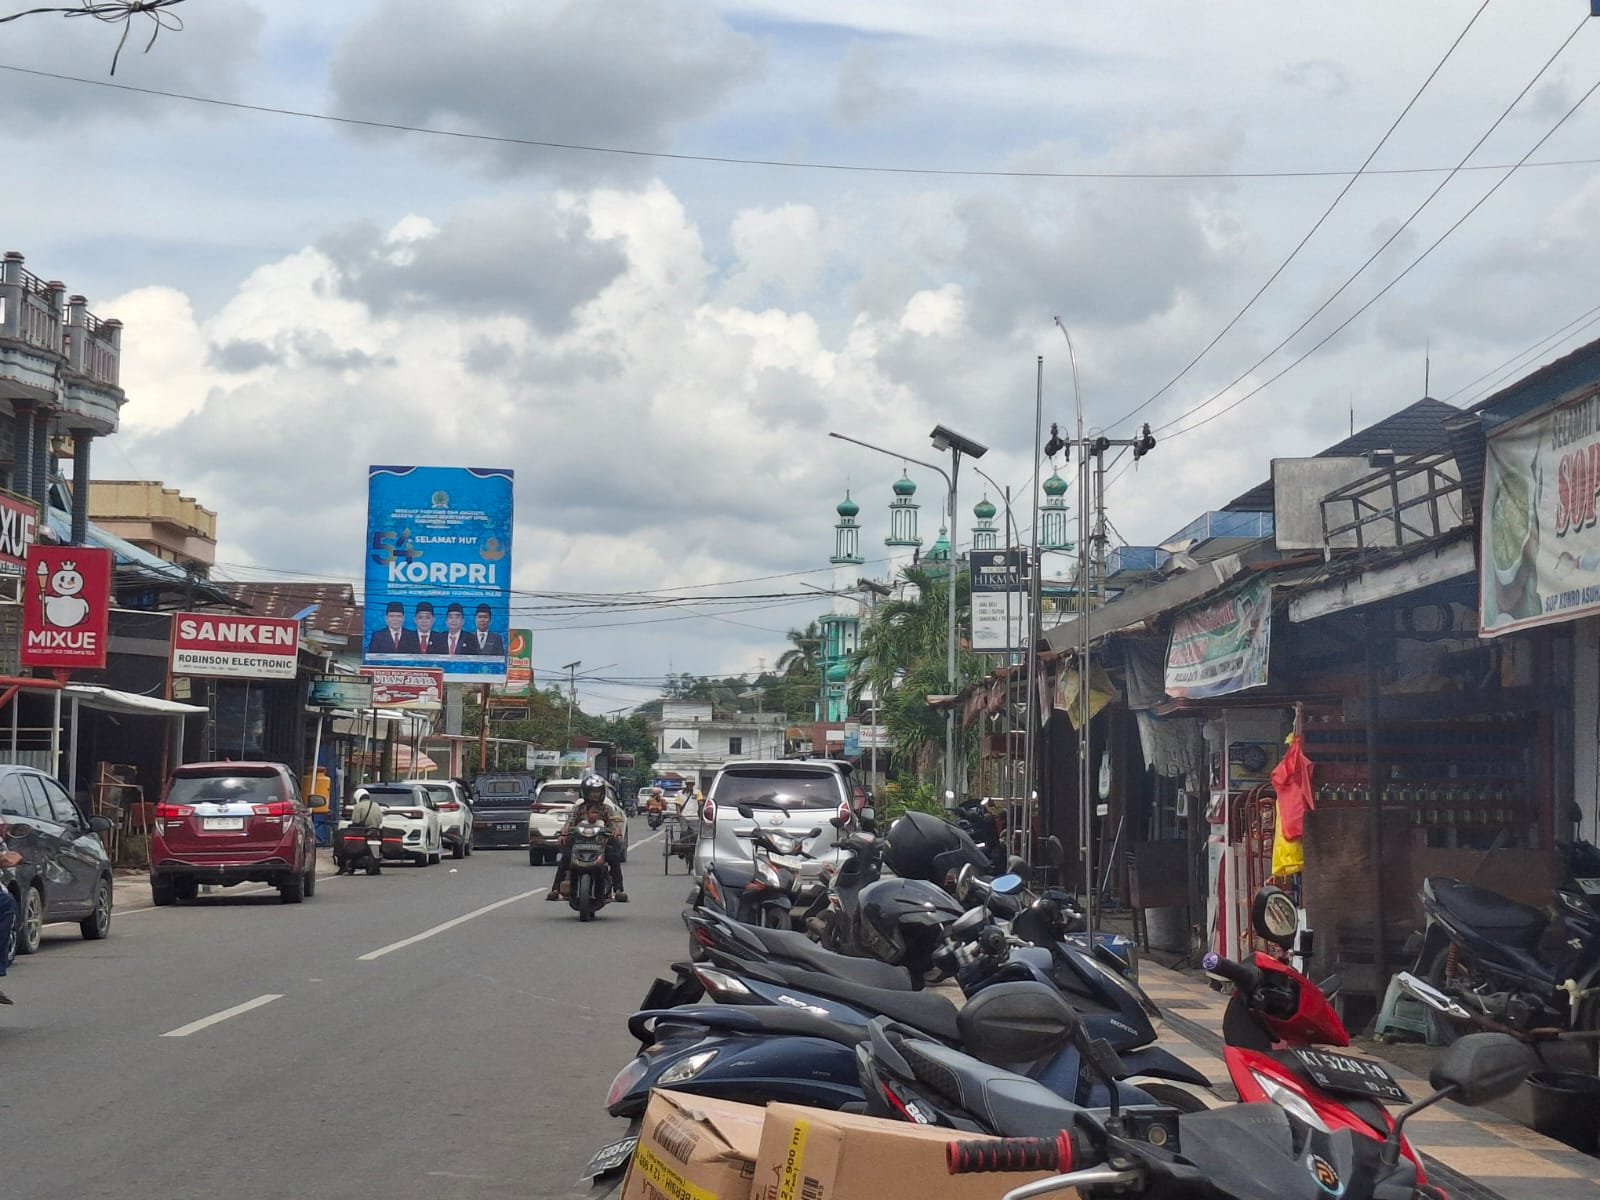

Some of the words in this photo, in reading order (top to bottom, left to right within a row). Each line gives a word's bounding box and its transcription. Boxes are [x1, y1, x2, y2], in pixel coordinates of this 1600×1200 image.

[0, 505, 35, 559] XUE
[415, 535, 456, 544] SELAMAT
[459, 536, 478, 545] HUT
[388, 561, 496, 584] KORPRI
[28, 630, 96, 649] MIXUE
[180, 620, 294, 645] SANKEN
[178, 654, 229, 665] ROBINSON
[231, 657, 293, 669] ELECTRONIC
[1110, 1018, 1138, 1036] HONDA
[1297, 1049, 1324, 1066] KT
[1320, 1053, 1367, 1075] 5239
[785, 1148, 797, 1175] 900
[792, 1127, 802, 1146] ml
